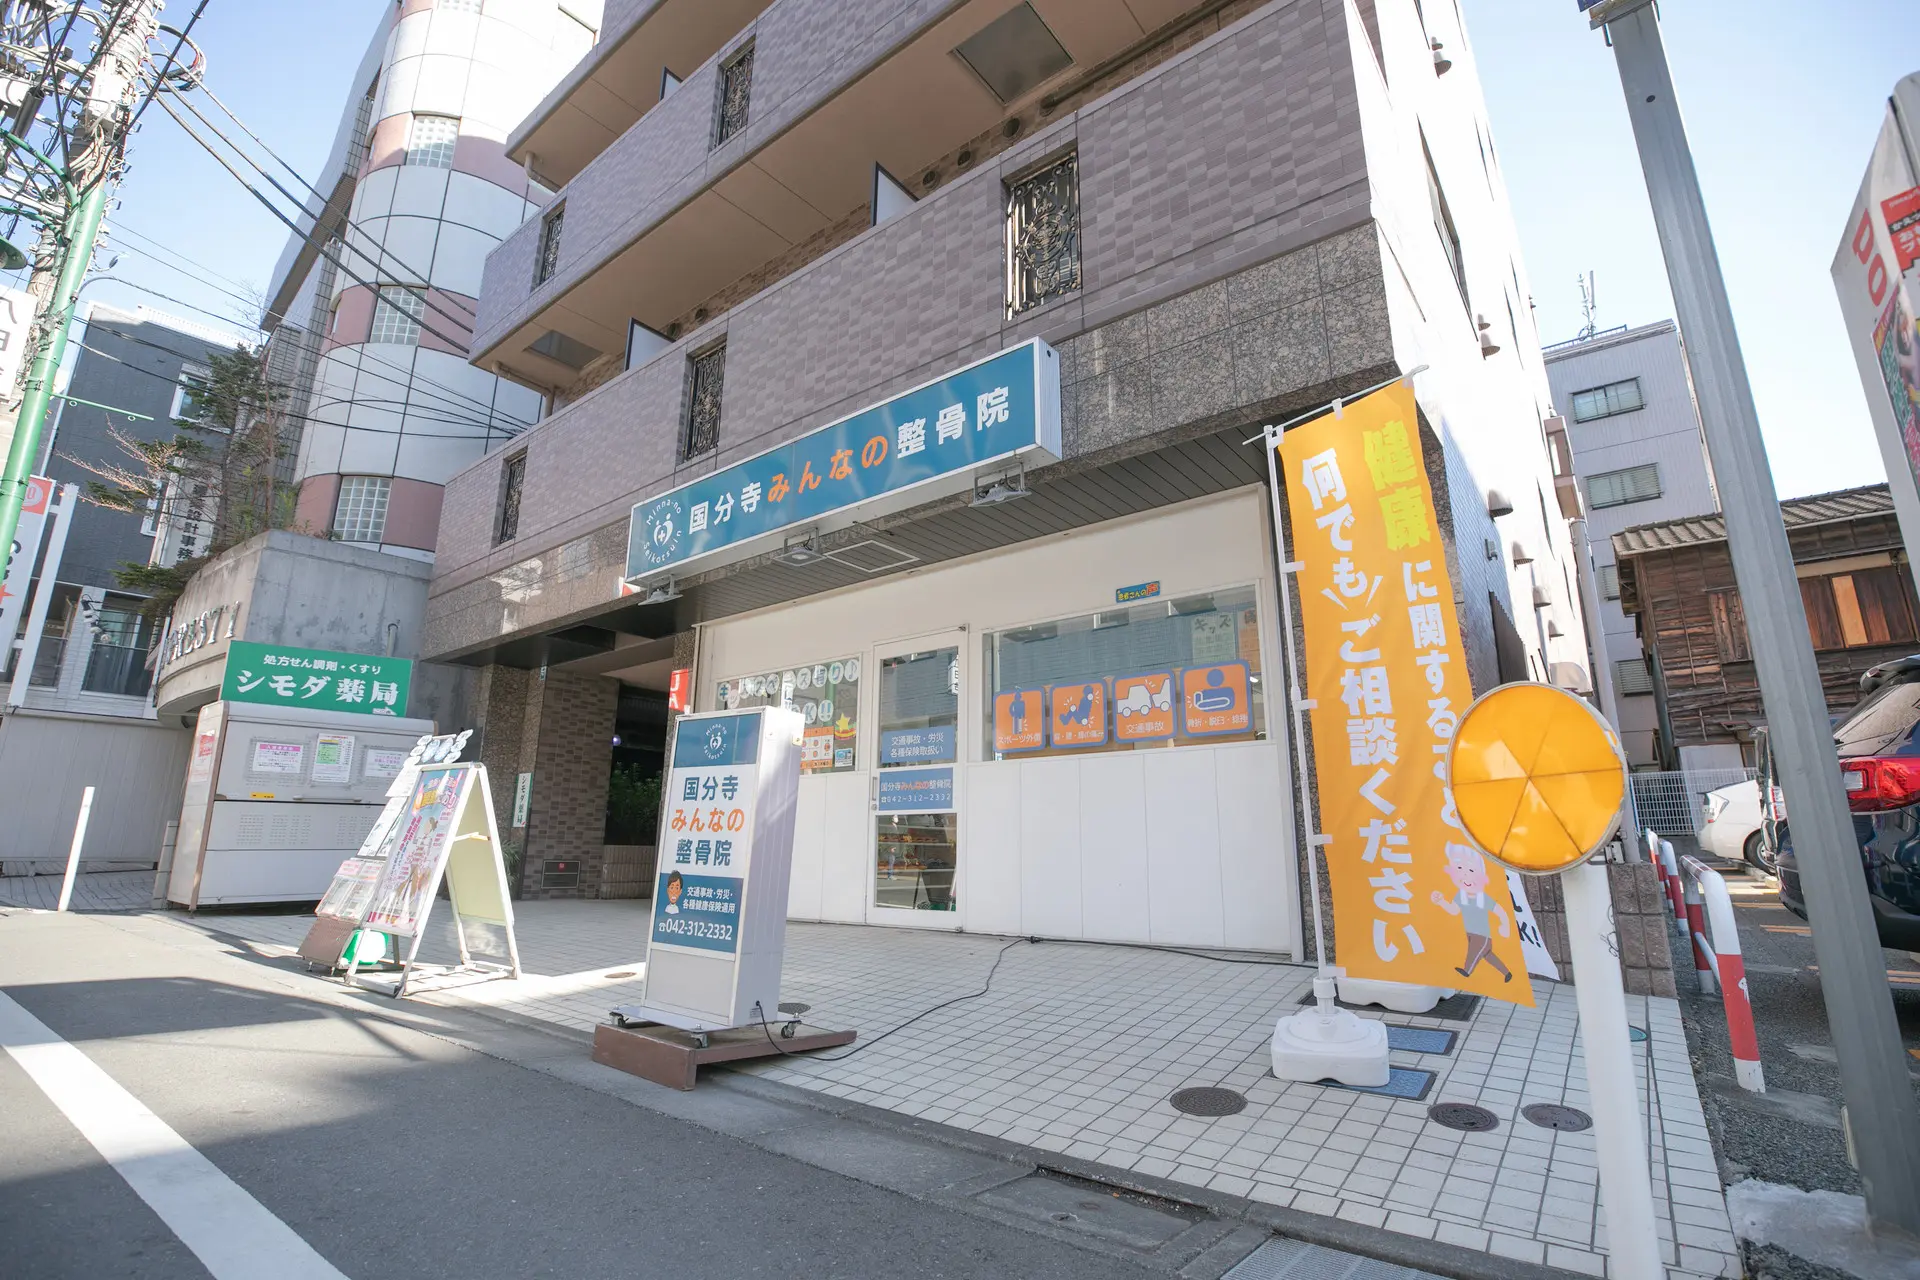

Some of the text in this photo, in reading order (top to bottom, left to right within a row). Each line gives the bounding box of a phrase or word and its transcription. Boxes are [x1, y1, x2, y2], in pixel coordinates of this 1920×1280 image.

[689, 387, 1009, 534] 国分寺みんなの整骨院
[646, 499, 682, 525] Minna-no
[643, 530, 682, 563] Seikotsuin
[263, 654, 381, 675] 処方せん調剤・くすり
[237, 670, 399, 706] シモダ薬局
[1302, 448, 1424, 962] 何でもご相談ください
[891, 732, 944, 746] 交通事故・労災
[1126, 721, 1164, 734] 交通事故
[683, 775, 739, 801] 国分寺
[881, 779, 952, 792] 国分寺みんなの整骨院
[671, 807, 745, 832] みんなの
[675, 838, 732, 866] 整骨院
[682, 899, 736, 914] 各種健康保険適用
